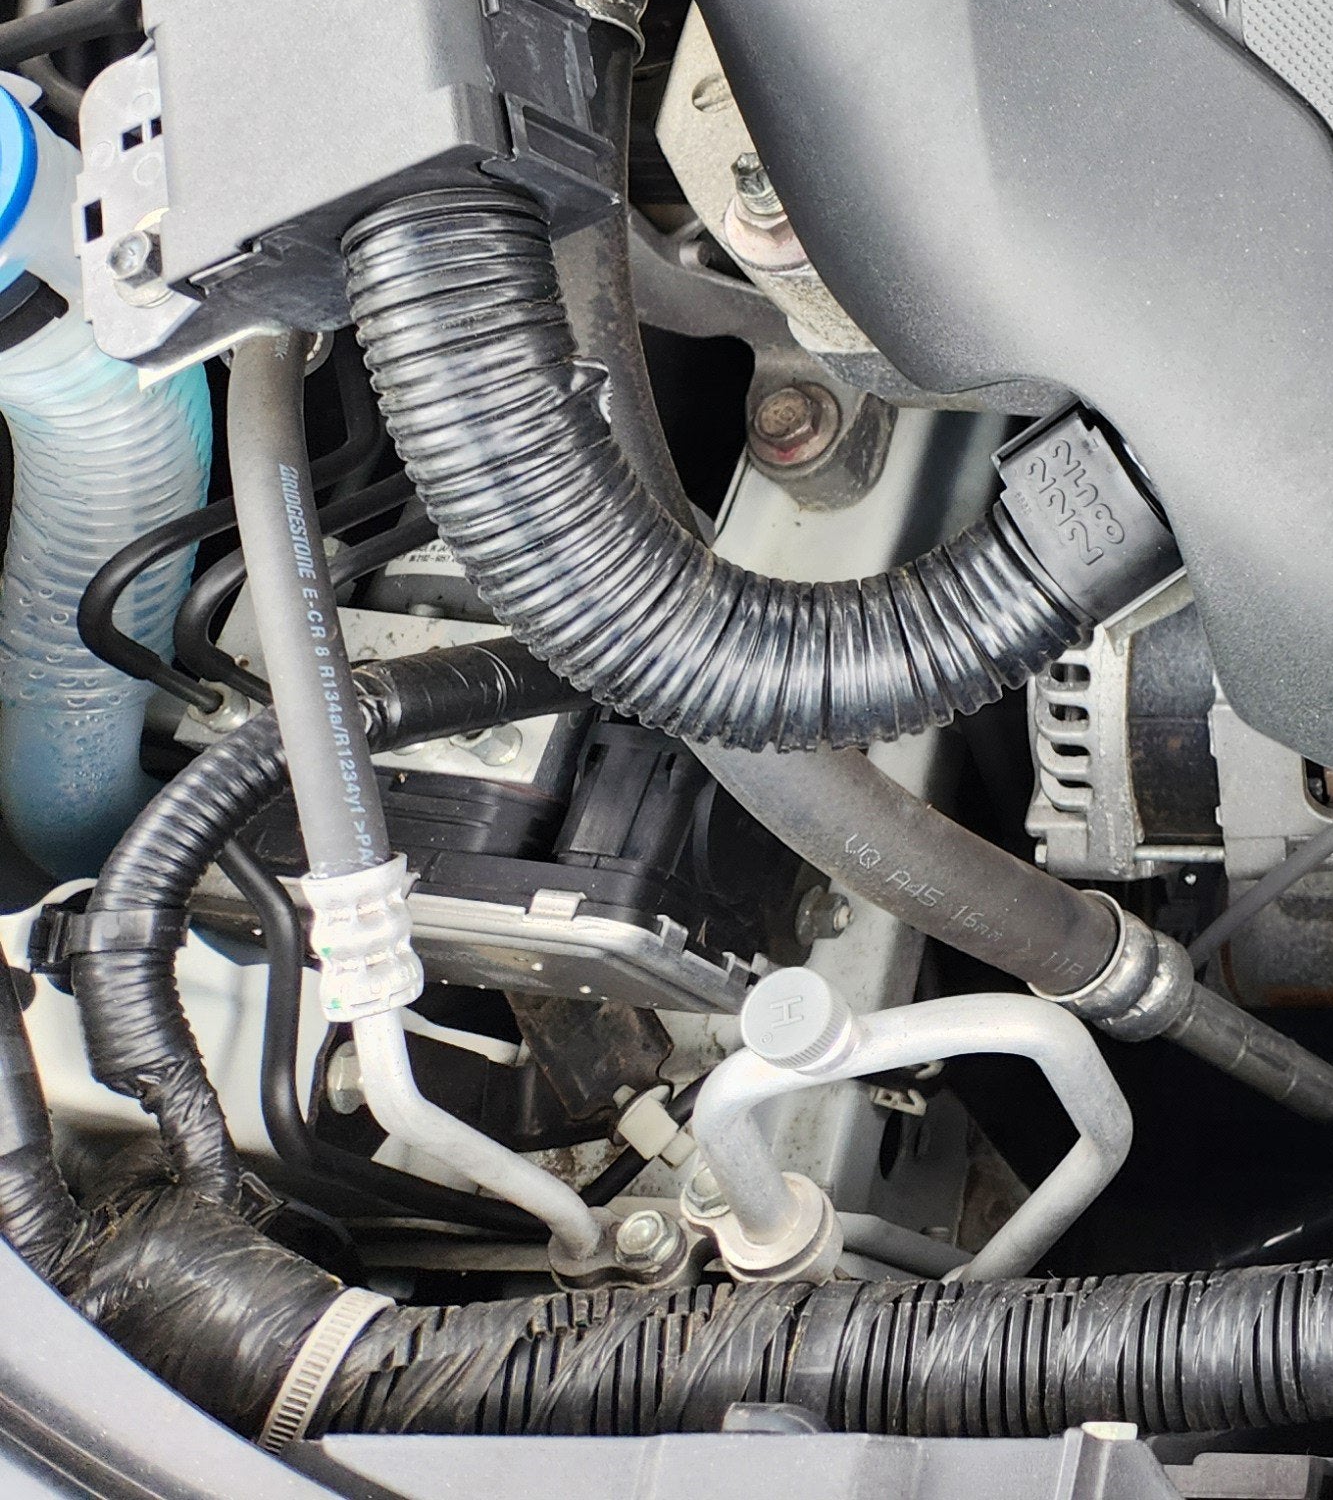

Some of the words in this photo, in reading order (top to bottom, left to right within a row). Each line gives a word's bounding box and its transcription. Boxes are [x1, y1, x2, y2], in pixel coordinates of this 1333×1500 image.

[278, 462, 316, 580] BRIDGESTONE
[302, 586, 326, 639] E-CR
[314, 646, 330, 658] 8
[768, 995, 804, 1030] H
